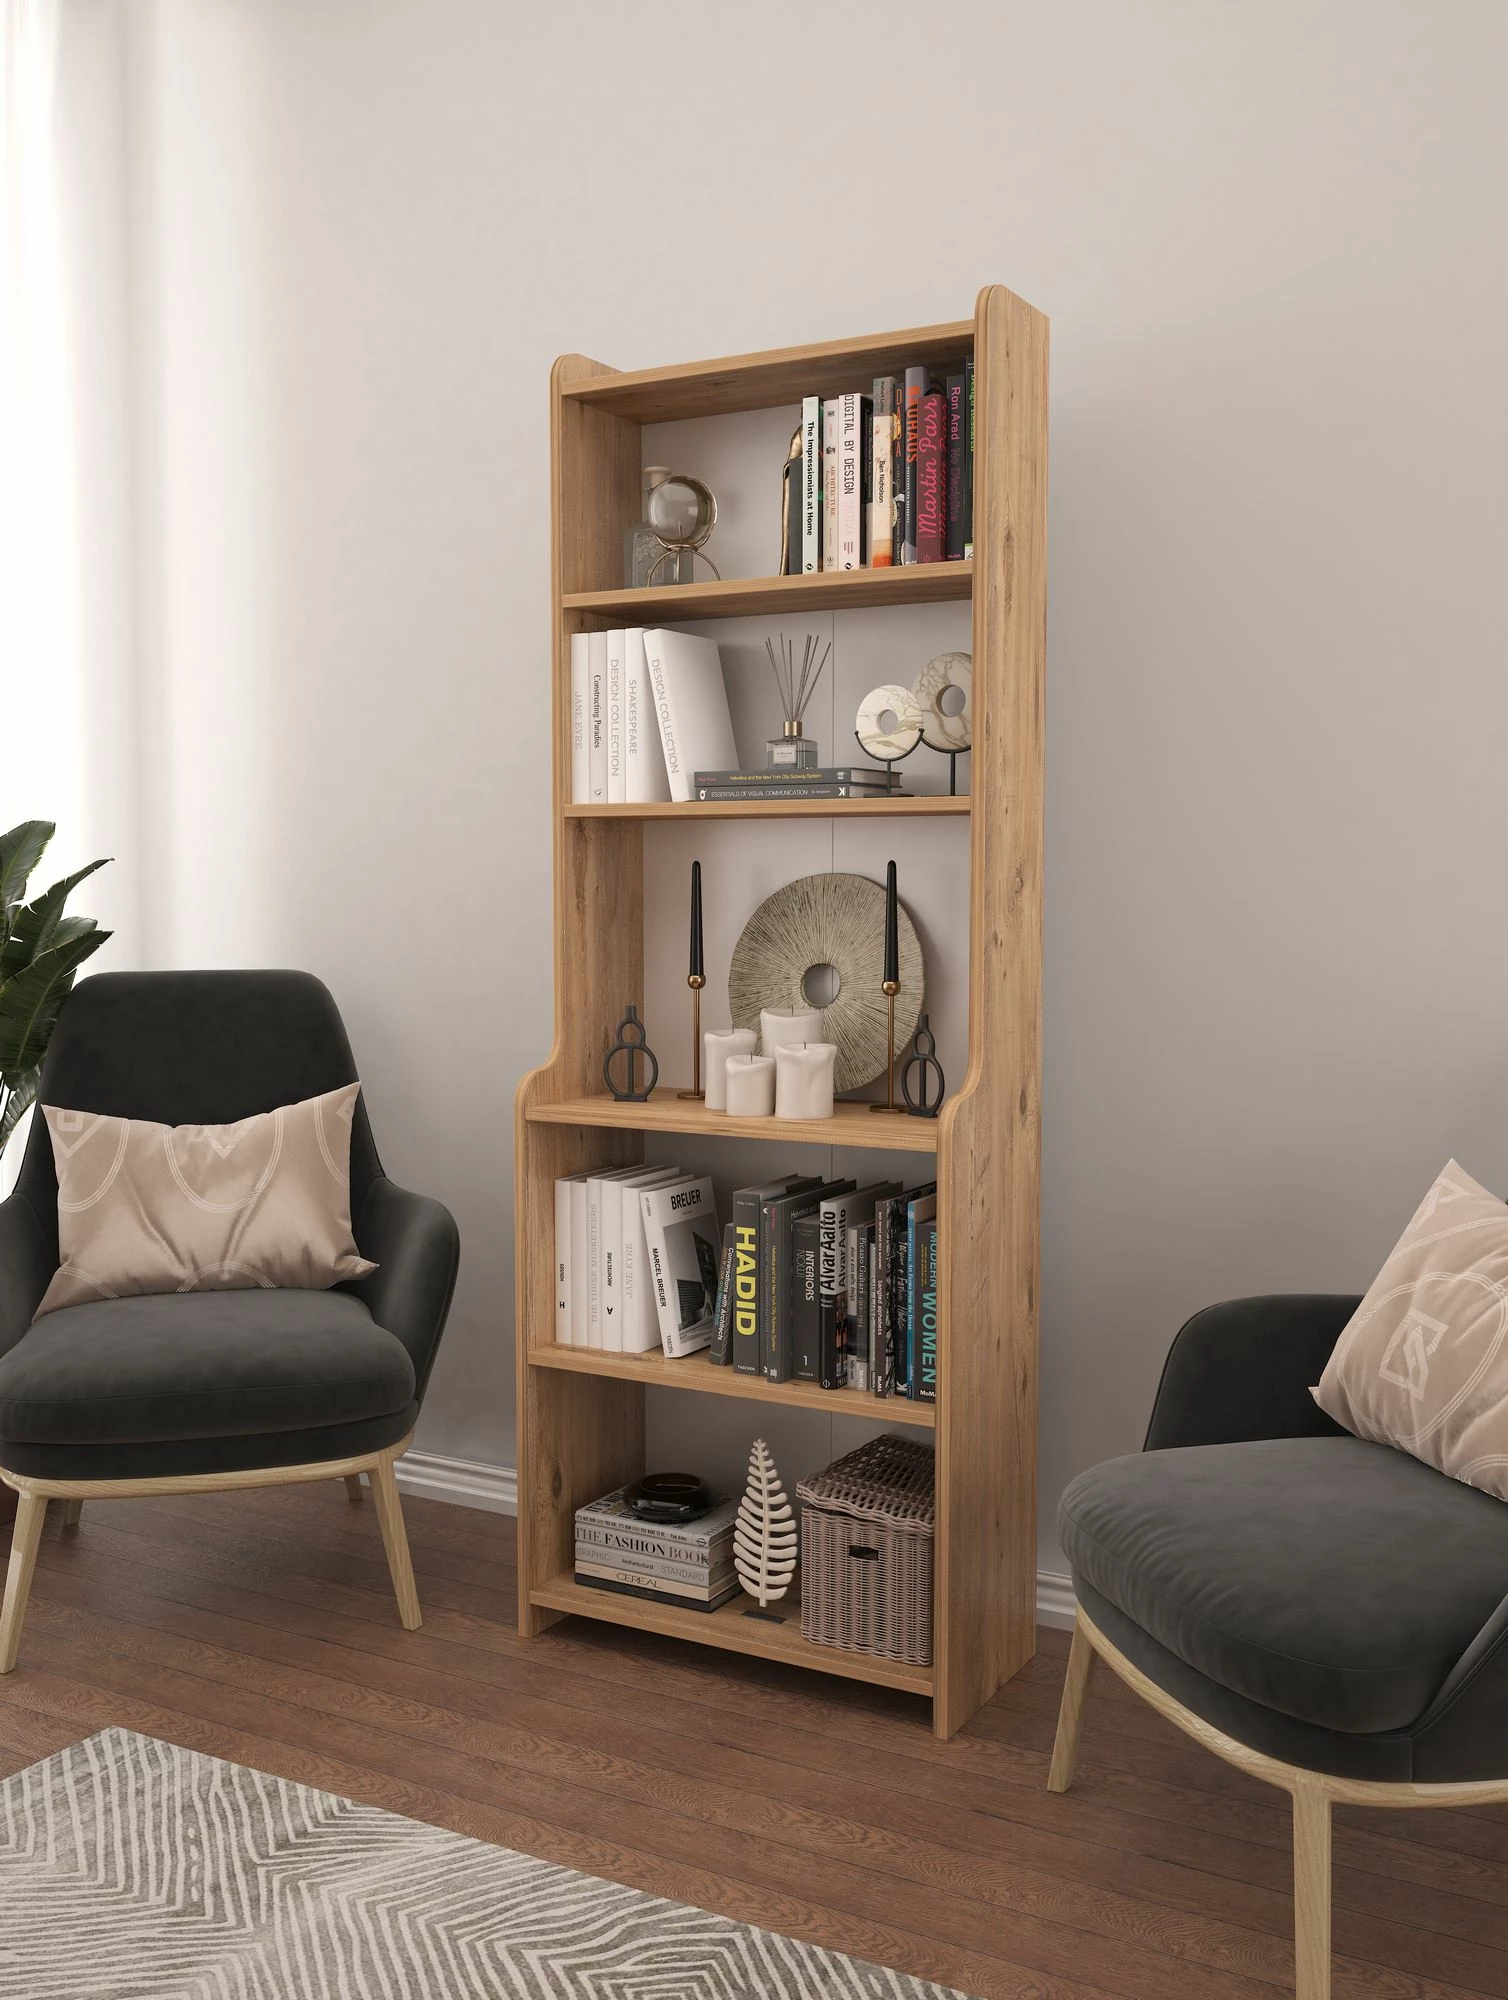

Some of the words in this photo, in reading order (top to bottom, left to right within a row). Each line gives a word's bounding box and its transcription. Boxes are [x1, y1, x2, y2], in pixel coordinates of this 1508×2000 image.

[844, 394, 855, 435] DIGITAL
[951, 386, 961, 409] Ron
[906, 385, 920, 463] BAUHAUS
[918, 397, 937, 452] Parr
[951, 413, 961, 440] Arad
[844, 440, 855, 452] BY
[806, 439, 815, 499] Impressionists
[844, 458, 855, 495] DESIGN
[807, 501, 814, 510] at
[918, 457, 938, 534] Martin
[593, 674, 602, 718] Constructing
[610, 659, 619, 702] DESIGN
[574, 691, 583, 719] JANE
[628, 679, 638, 755] SHAKESPEARE
[651, 658, 667, 701] DESIGN
[659, 703, 680, 774] COLLECTION
[575, 722, 584, 750] EYRE
[593, 719, 602, 748] Paradies
[610, 704, 620, 777] COLLECTION
[711, 790, 739, 798] ESSENTIALS
[765, 789, 808, 797] COMMUNICATION
[671, 1188, 702, 1210] BREUER
[590, 1203, 598, 1269] MUSKETEERS
[820, 1211, 836, 1251] Aalto
[837, 1208, 846, 1251] Aalto
[625, 1242, 633, 1269] EYRE
[796, 1249, 806, 1278] NOW!
[859, 1237, 867, 1264] Picasso
[625, 1272, 633, 1299] JANE
[651, 1247, 662, 1278] MARCEL
[657, 1278, 667, 1307] BREUER
[723, 1247, 734, 1292] Conversations
[735, 1226, 757, 1336] HADID
[805, 1250, 815, 1301] INTERIORS
[820, 1251, 836, 1291] Alvar
[837, 1251, 846, 1288] Alvar
[859, 1265, 867, 1294] Guitars
[559, 1301, 565, 1309] H
[590, 1305, 598, 1324] THE
[606, 1307, 614, 1315] A
[717, 1308, 727, 1341] Architects
[922, 1292, 937, 1384] WOMEN
[803, 1354, 808, 1366] 1
[576, 1527, 602, 1544] THE
[604, 1533, 665, 1556] FASHION
[669, 1547, 710, 1566] BOOK
[576, 1547, 610, 1562] GRAPHIC
[660, 1565, 705, 1582] STANDARD
[616, 1572, 663, 1590] CEREAL
